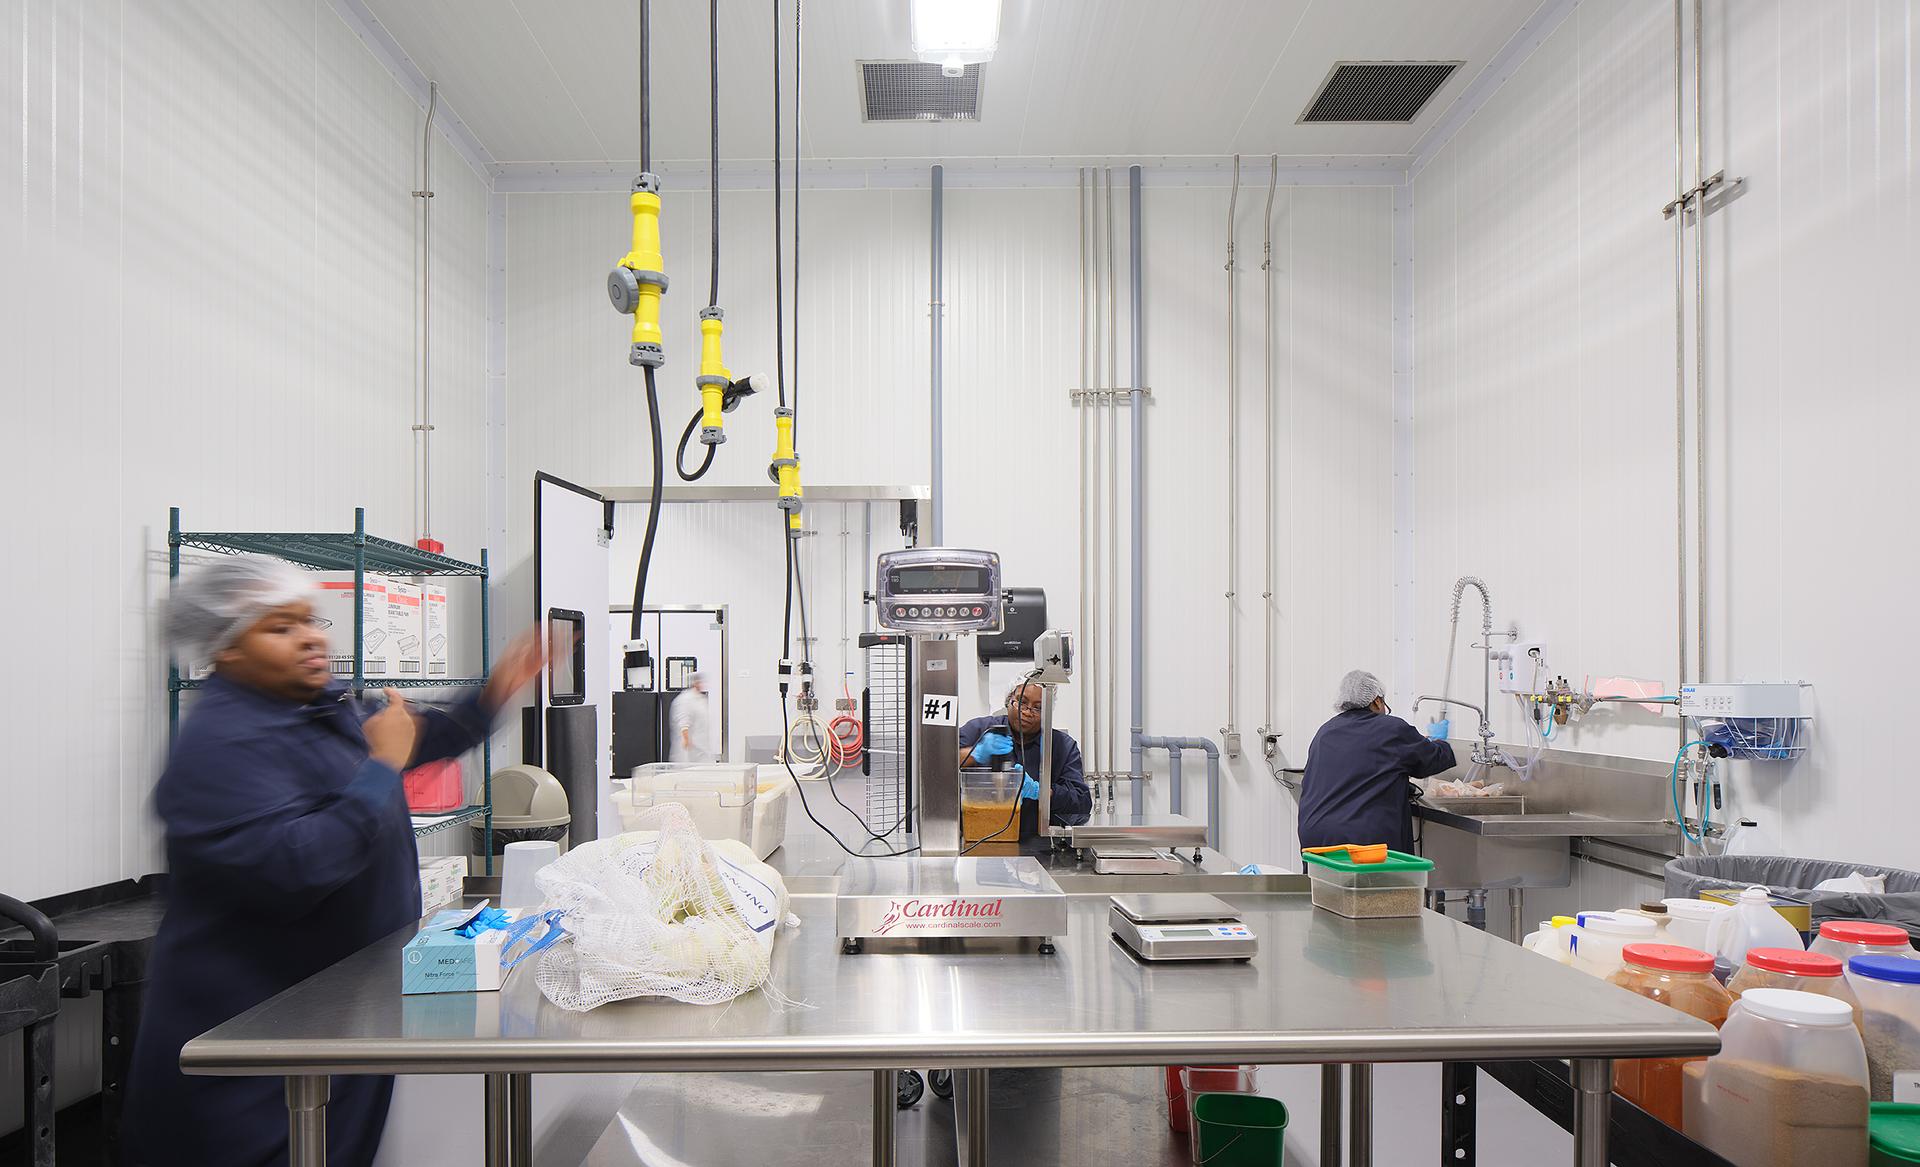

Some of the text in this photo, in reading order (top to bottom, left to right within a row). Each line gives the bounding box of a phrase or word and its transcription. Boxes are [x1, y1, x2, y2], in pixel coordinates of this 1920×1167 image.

[924, 699, 951, 720] #1
[902, 899, 1002, 918] Cardinal
[905, 921, 1001, 929] www.cardinalscale.com
